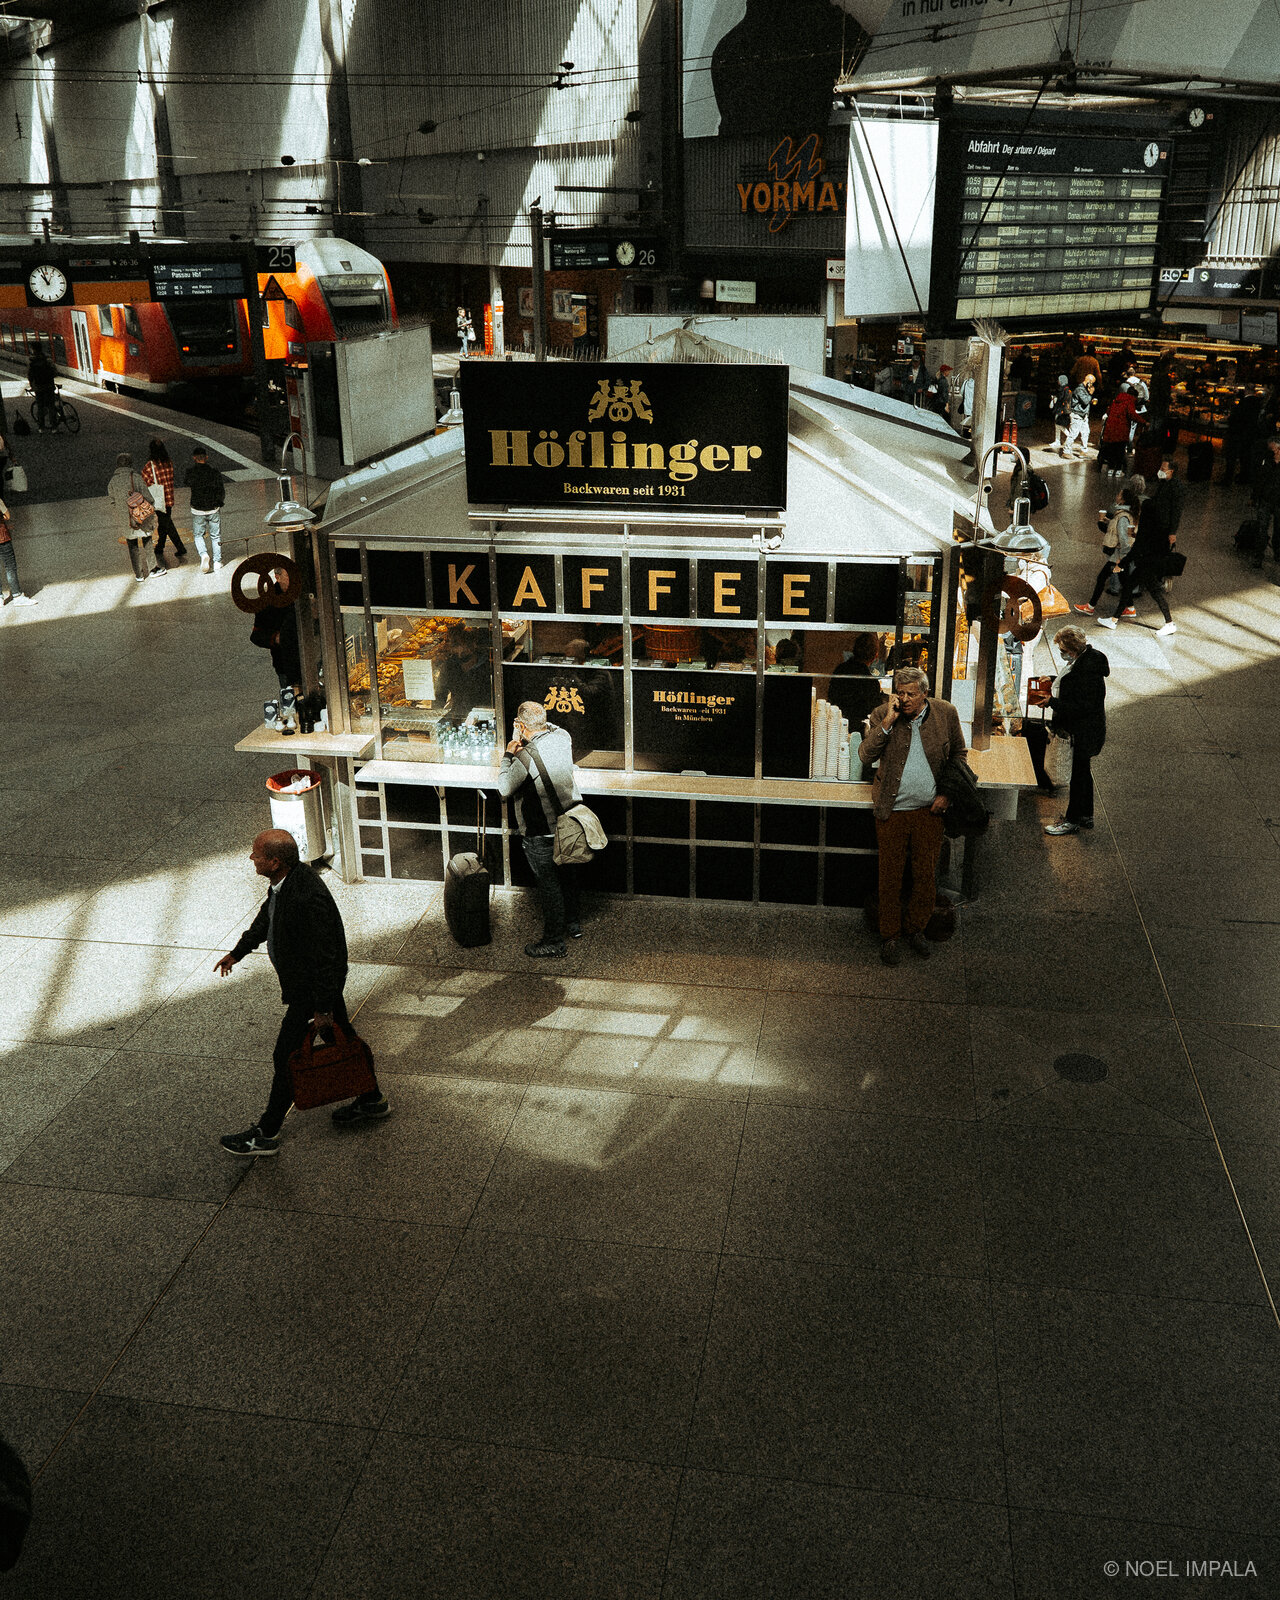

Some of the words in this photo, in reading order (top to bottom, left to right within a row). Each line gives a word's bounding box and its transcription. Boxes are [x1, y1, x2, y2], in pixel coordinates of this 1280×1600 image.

[968, 140, 1000, 154] Abfahrt
[736, 180, 848, 213] YORMA'
[268, 247, 292, 268] 25
[639, 250, 656, 266] 26
[836, 265, 845, 274] SP
[488, 430, 762, 482] Höflinger
[563, 482, 630, 496] Backwaren
[633, 484, 654, 496] seit
[658, 485, 686, 497] 1931
[448, 564, 810, 616] KAFFEE
[652, 690, 736, 708] Höflinger
[661, 706, 697, 714] Backwaren
[683, 714, 713, 722] München
